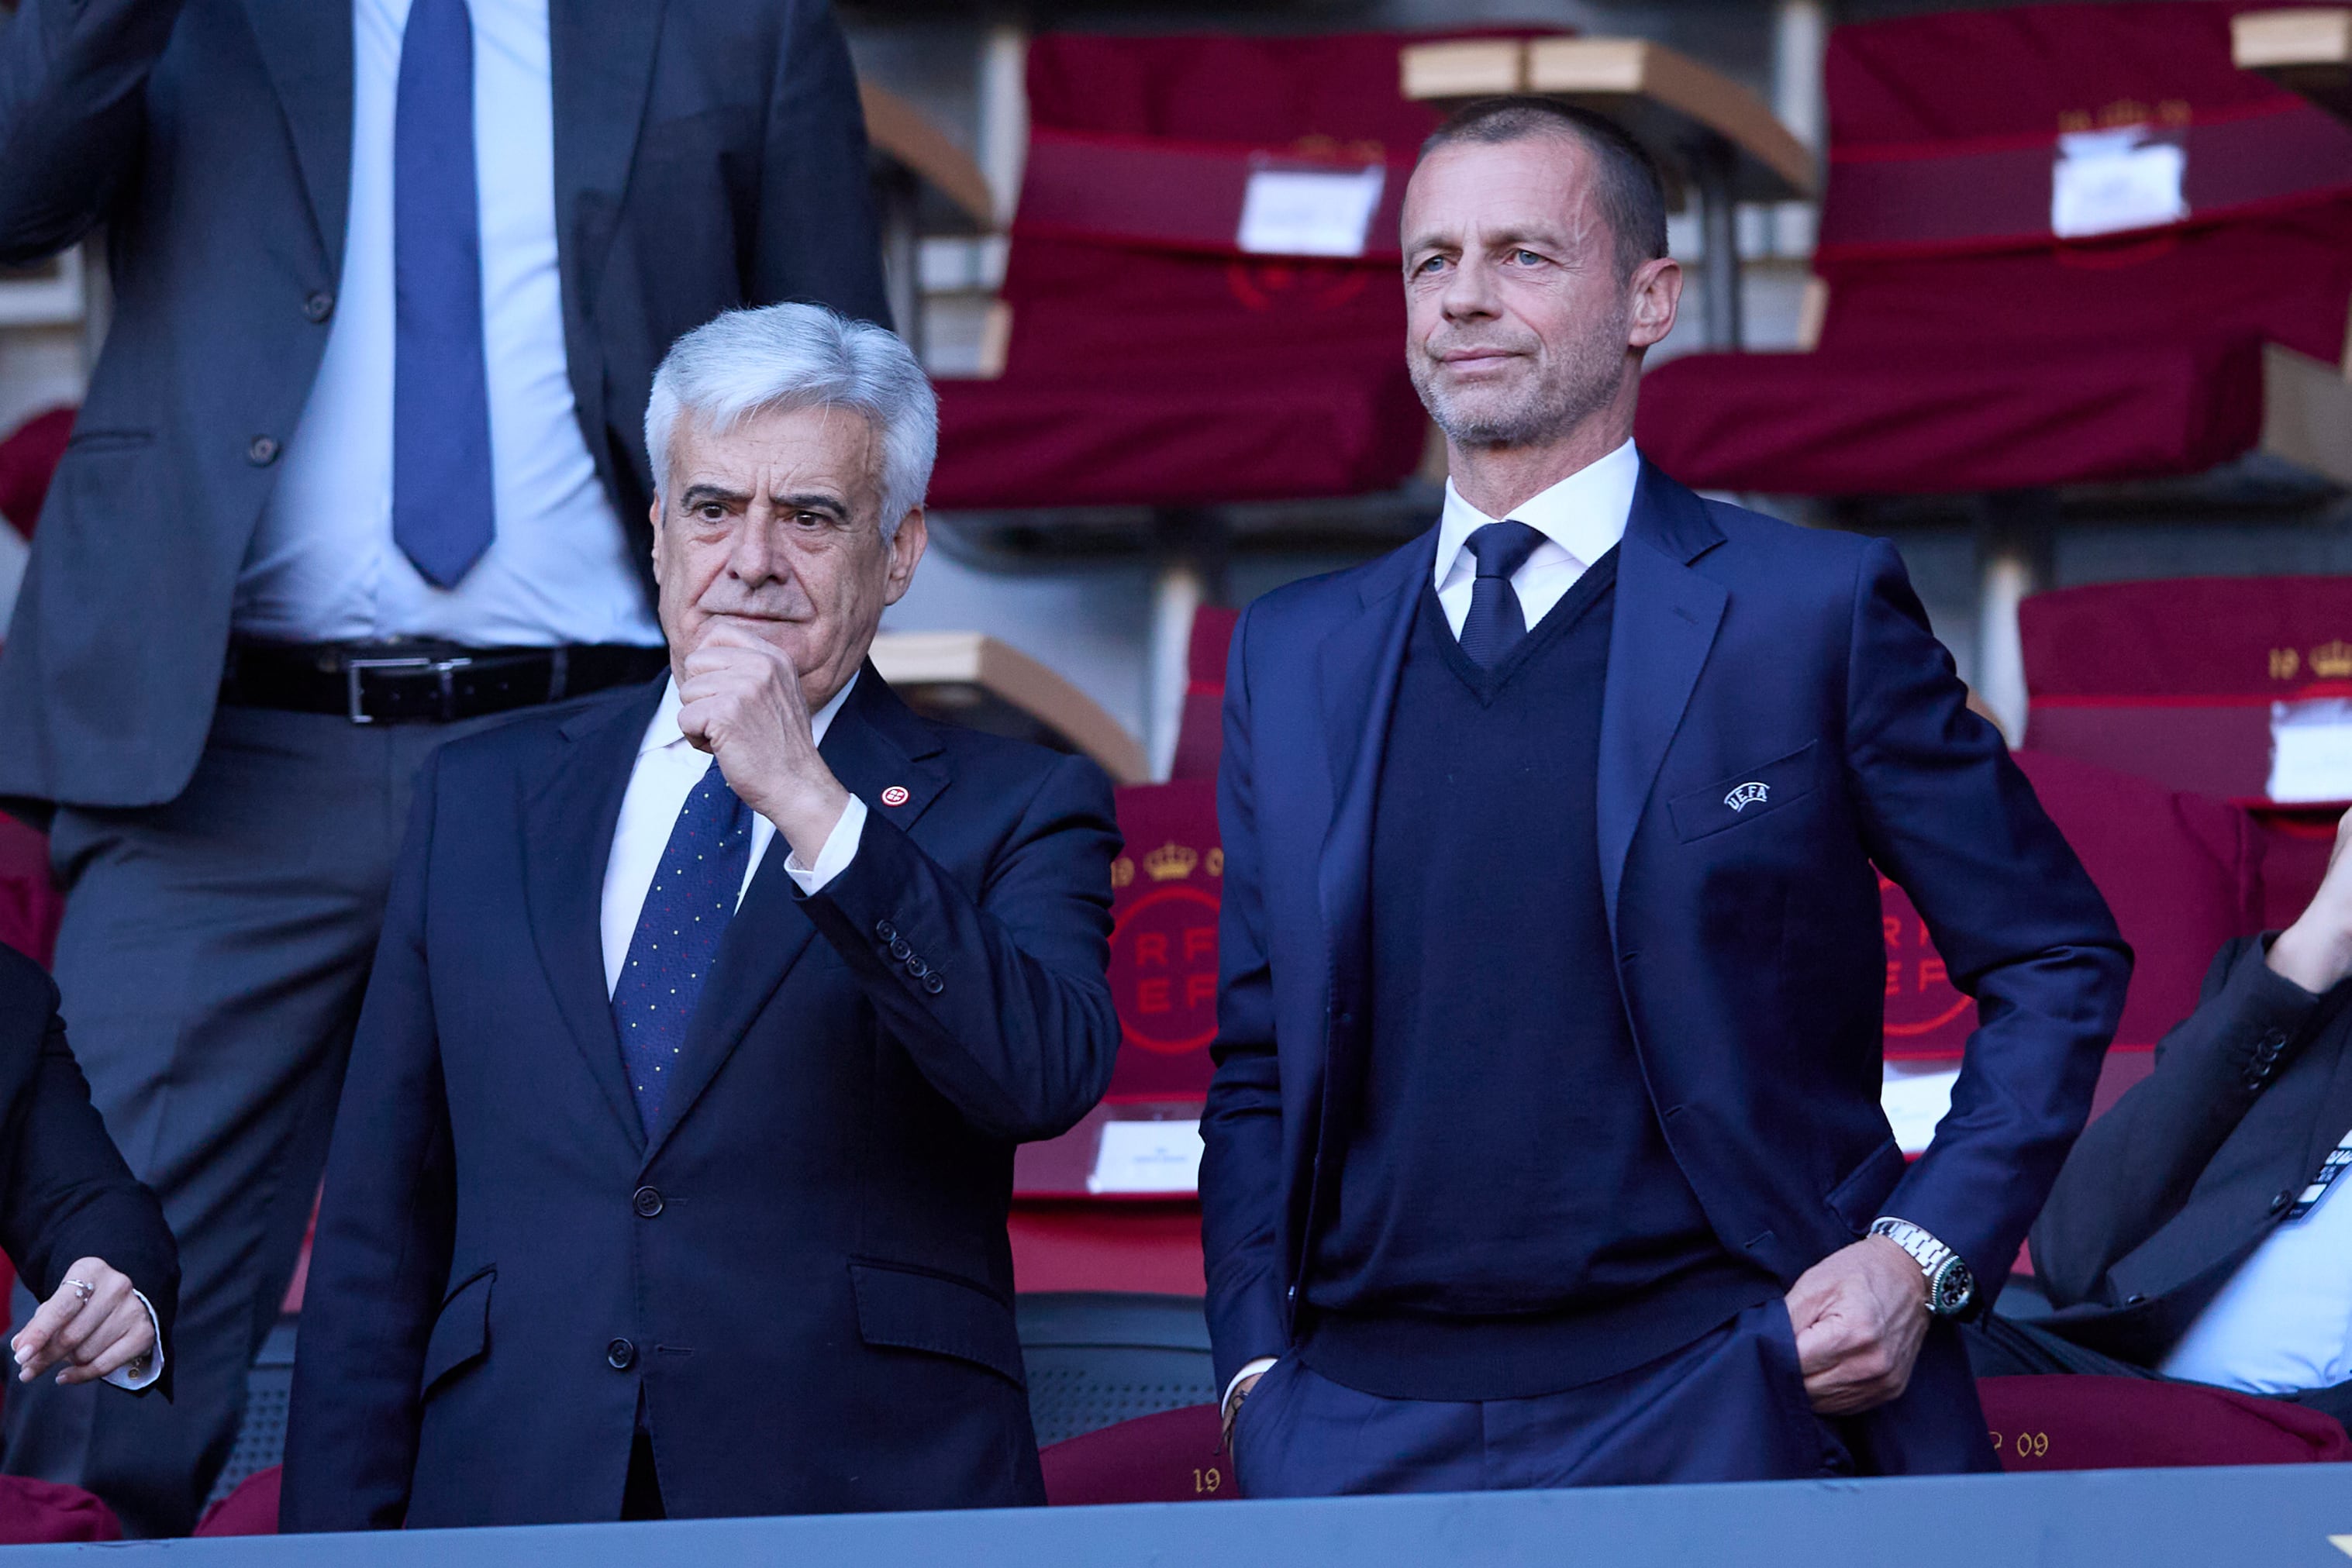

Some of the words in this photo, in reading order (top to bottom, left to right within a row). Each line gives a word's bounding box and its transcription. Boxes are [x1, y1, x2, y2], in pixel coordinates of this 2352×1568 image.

[1728, 786, 1767, 810] UEFA
[1136, 927, 1216, 967] RF
[1138, 973, 1218, 1014] EF
[2017, 1432, 2049, 1458] 09
[1193, 1467, 1221, 1493] 19
